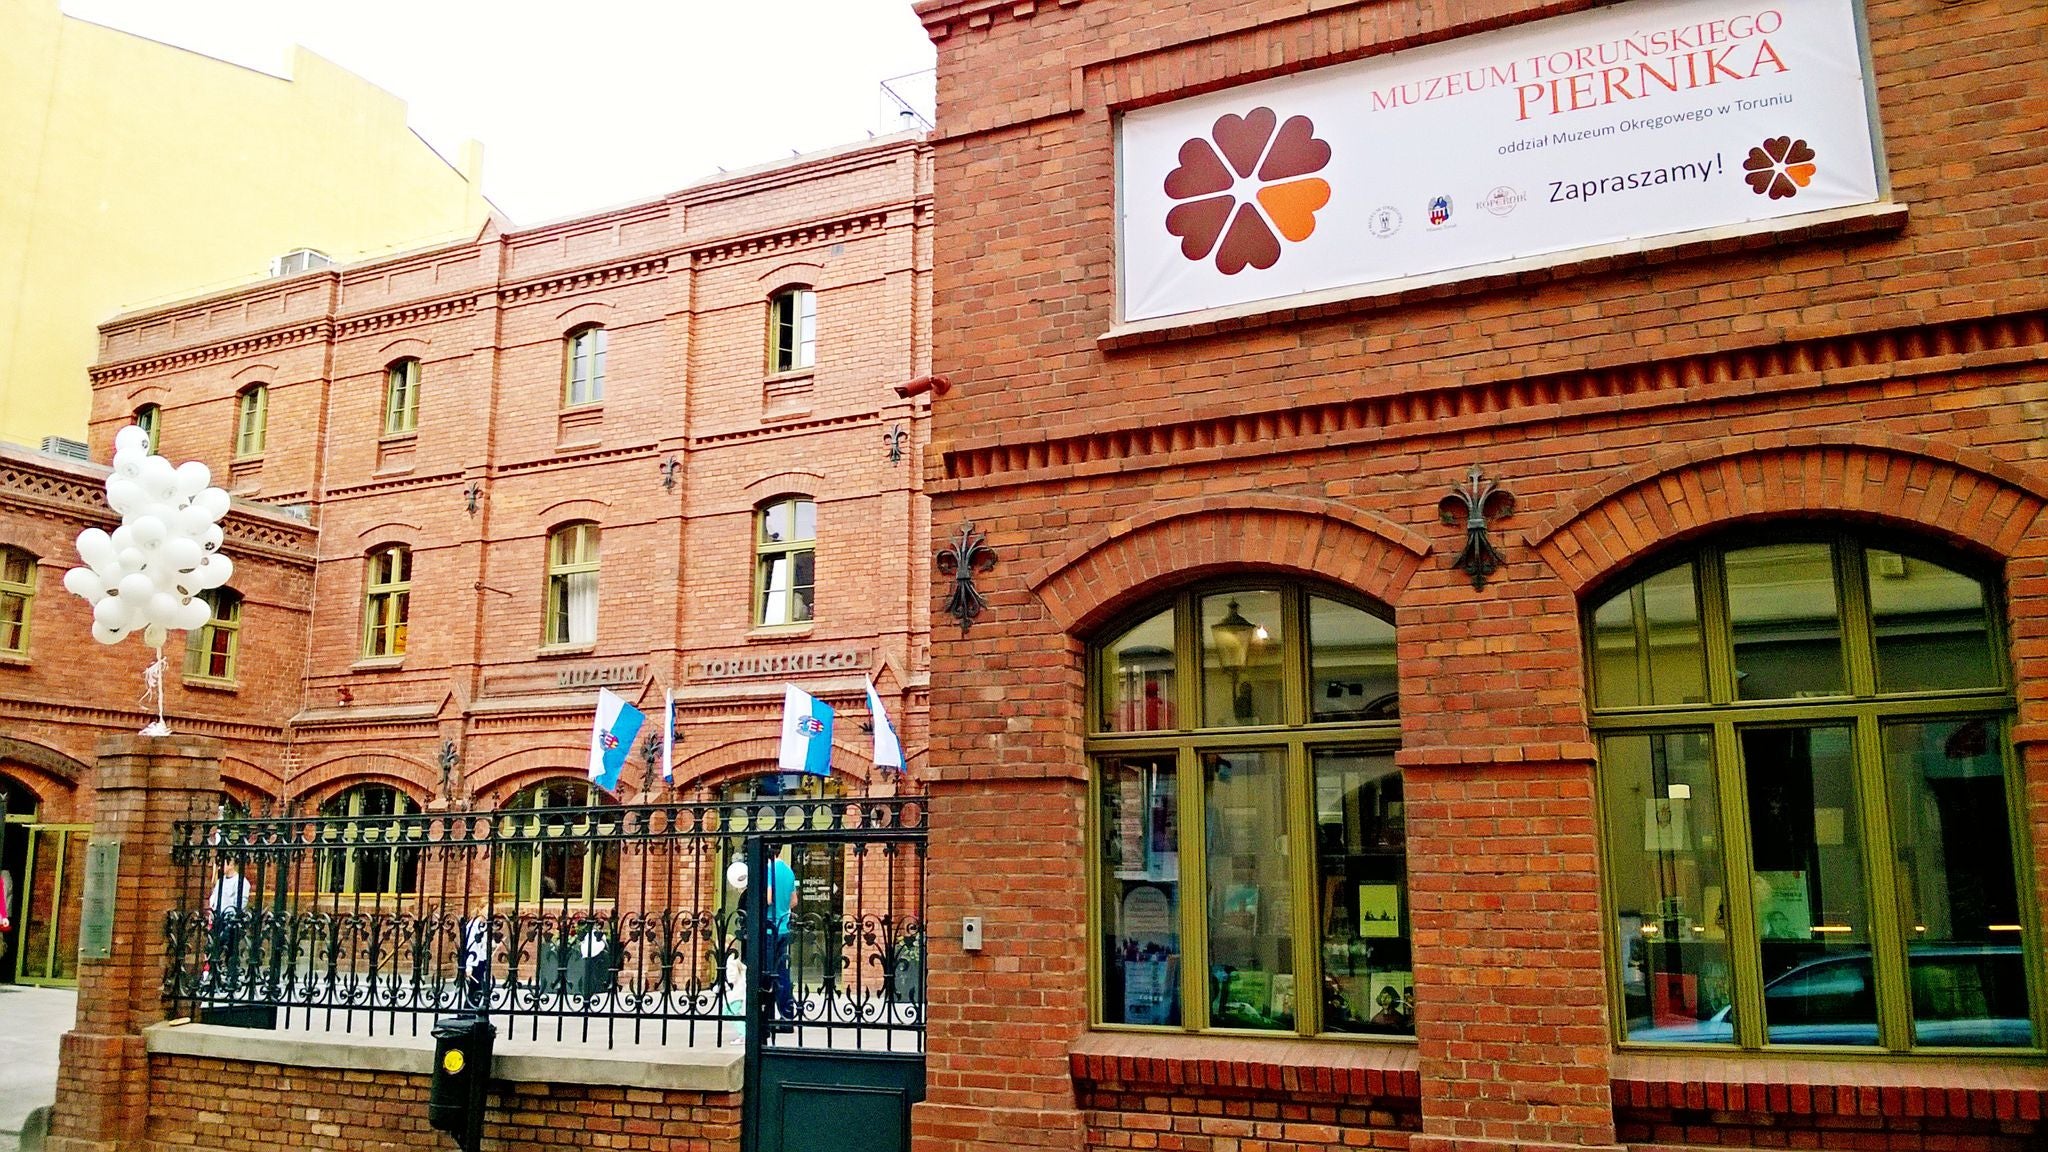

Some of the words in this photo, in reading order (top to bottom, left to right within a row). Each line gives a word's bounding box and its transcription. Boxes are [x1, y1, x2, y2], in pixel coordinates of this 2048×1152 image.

[1370, 62, 1518, 112] MUZEUM
[1527, 9, 1783, 78] TORUŃSKIEGO
[1513, 38, 1791, 121] PIERNIKA
[1497, 135, 1549, 155] oddział
[1552, 123, 1616, 145] Muzeum
[1619, 107, 1714, 133] Okręgowego
[1716, 103, 1731, 115] w
[1734, 92, 1794, 112] Toruniu
[1548, 152, 1724, 203] Zapraszamy!
[557, 664, 644, 688] MUZEUM
